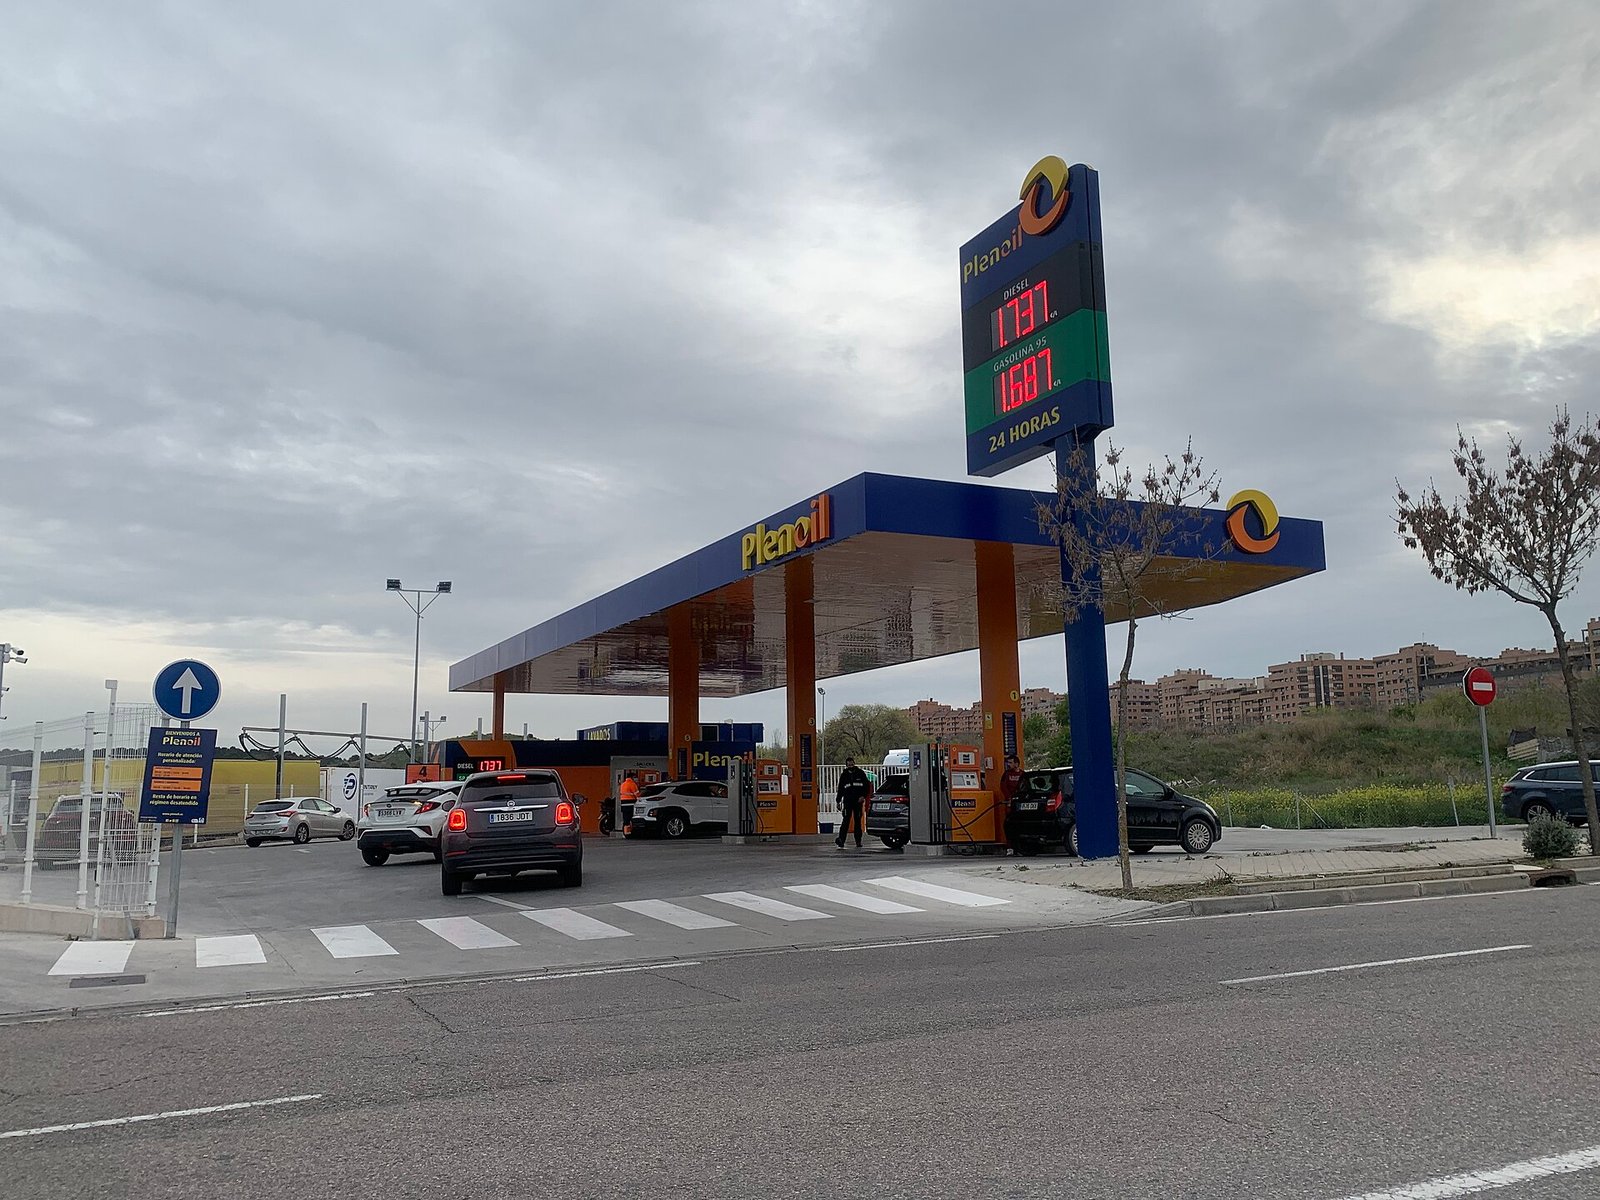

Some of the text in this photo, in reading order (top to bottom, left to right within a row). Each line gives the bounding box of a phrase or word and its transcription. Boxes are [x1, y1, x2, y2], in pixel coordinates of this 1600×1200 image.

[963, 224, 1022, 284] Plenoil
[1003, 278, 1029, 300] DIESEL
[998, 280, 1048, 348] 1.737
[993, 336, 1047, 372] GASOLINA 95
[1001, 348, 1052, 413] 1.687
[988, 406, 1061, 453] 24 HORAS
[742, 493, 830, 571] Plenoil
[162, 736, 201, 746] Plenoil
[418, 766, 427, 777] 4
[496, 813, 514, 821] 1836
